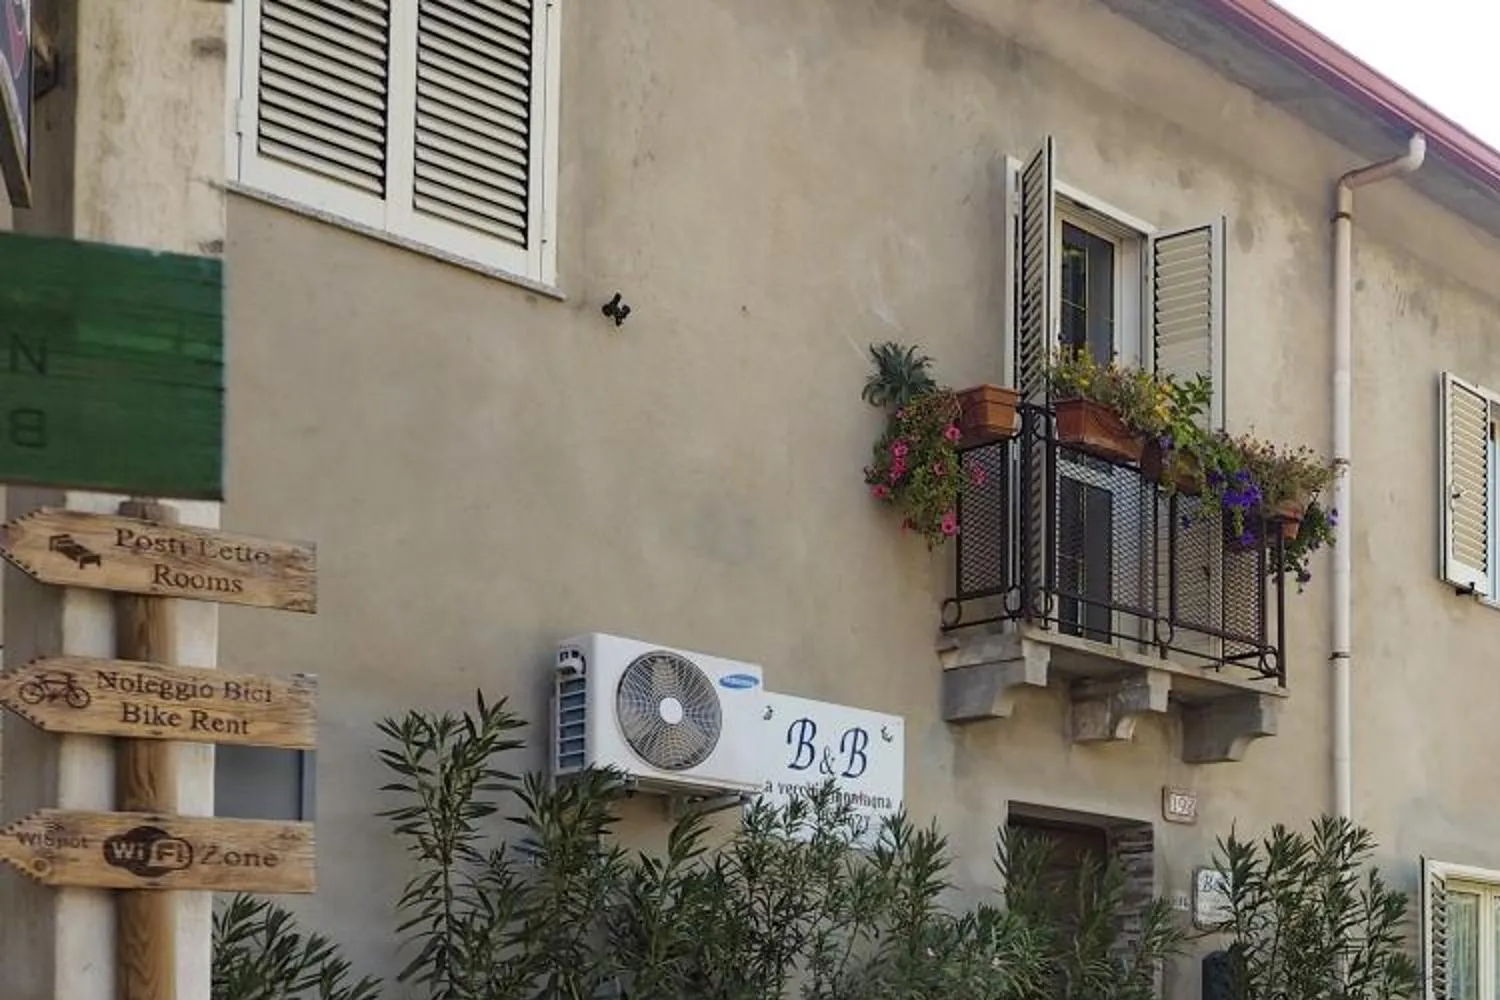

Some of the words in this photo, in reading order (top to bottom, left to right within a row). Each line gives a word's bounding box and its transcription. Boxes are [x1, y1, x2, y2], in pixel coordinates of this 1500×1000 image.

[114, 527, 187, 556] Posti
[200, 537, 271, 565] Letto
[152, 563, 244, 593] Rooms
[96, 670, 214, 701] Noleggio
[223, 680, 273, 703] Bici
[120, 701, 183, 728] Bike
[190, 709, 251, 736] Rent
[786, 717, 869, 779] B&B
[111, 840, 187, 867] WiFi
[199, 846, 279, 868] Zone
